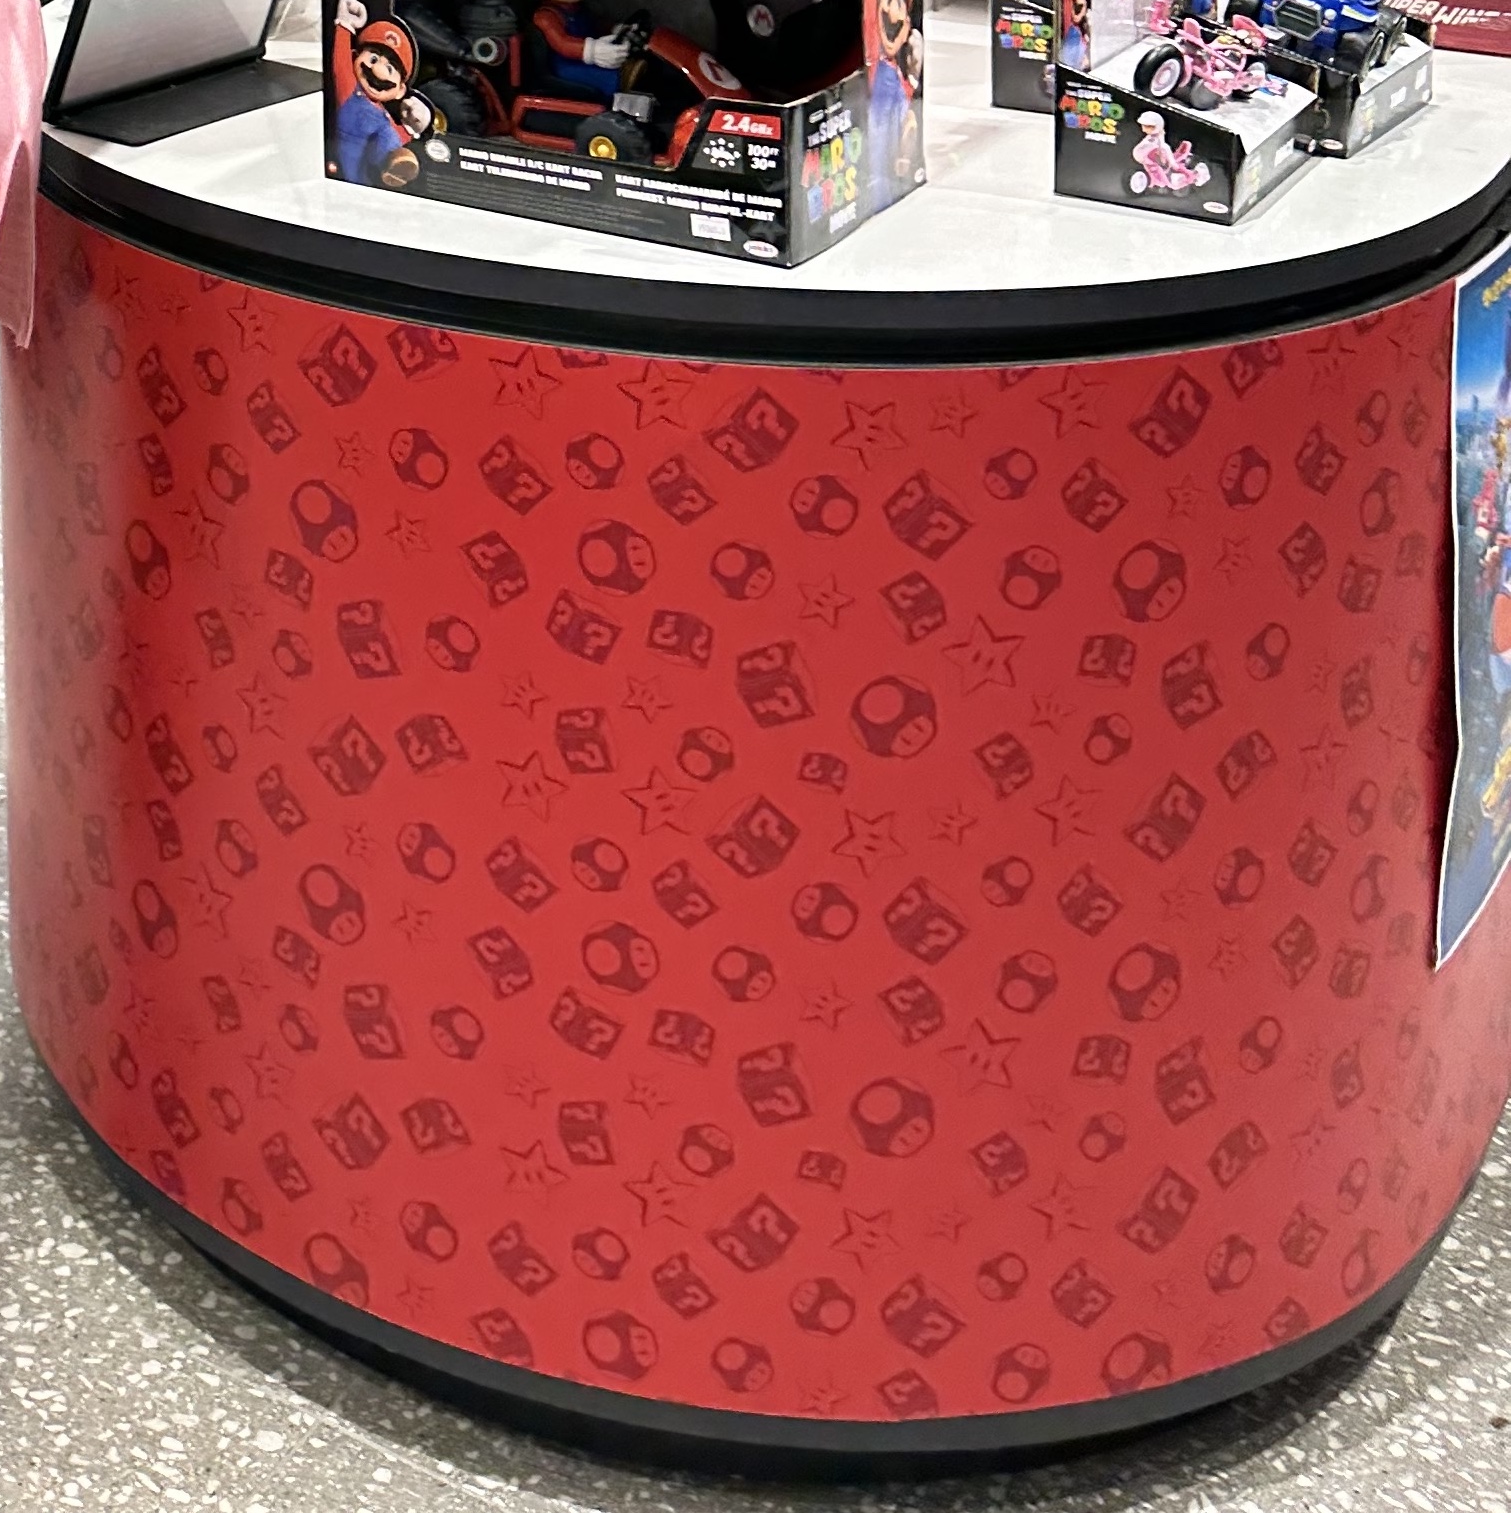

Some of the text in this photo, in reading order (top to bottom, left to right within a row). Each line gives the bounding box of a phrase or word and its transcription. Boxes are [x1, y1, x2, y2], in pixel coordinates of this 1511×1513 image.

[995, 18, 1055, 39] MARIO
[1059, 94, 1126, 121] MARIO
[801, 127, 863, 189] MARIO
